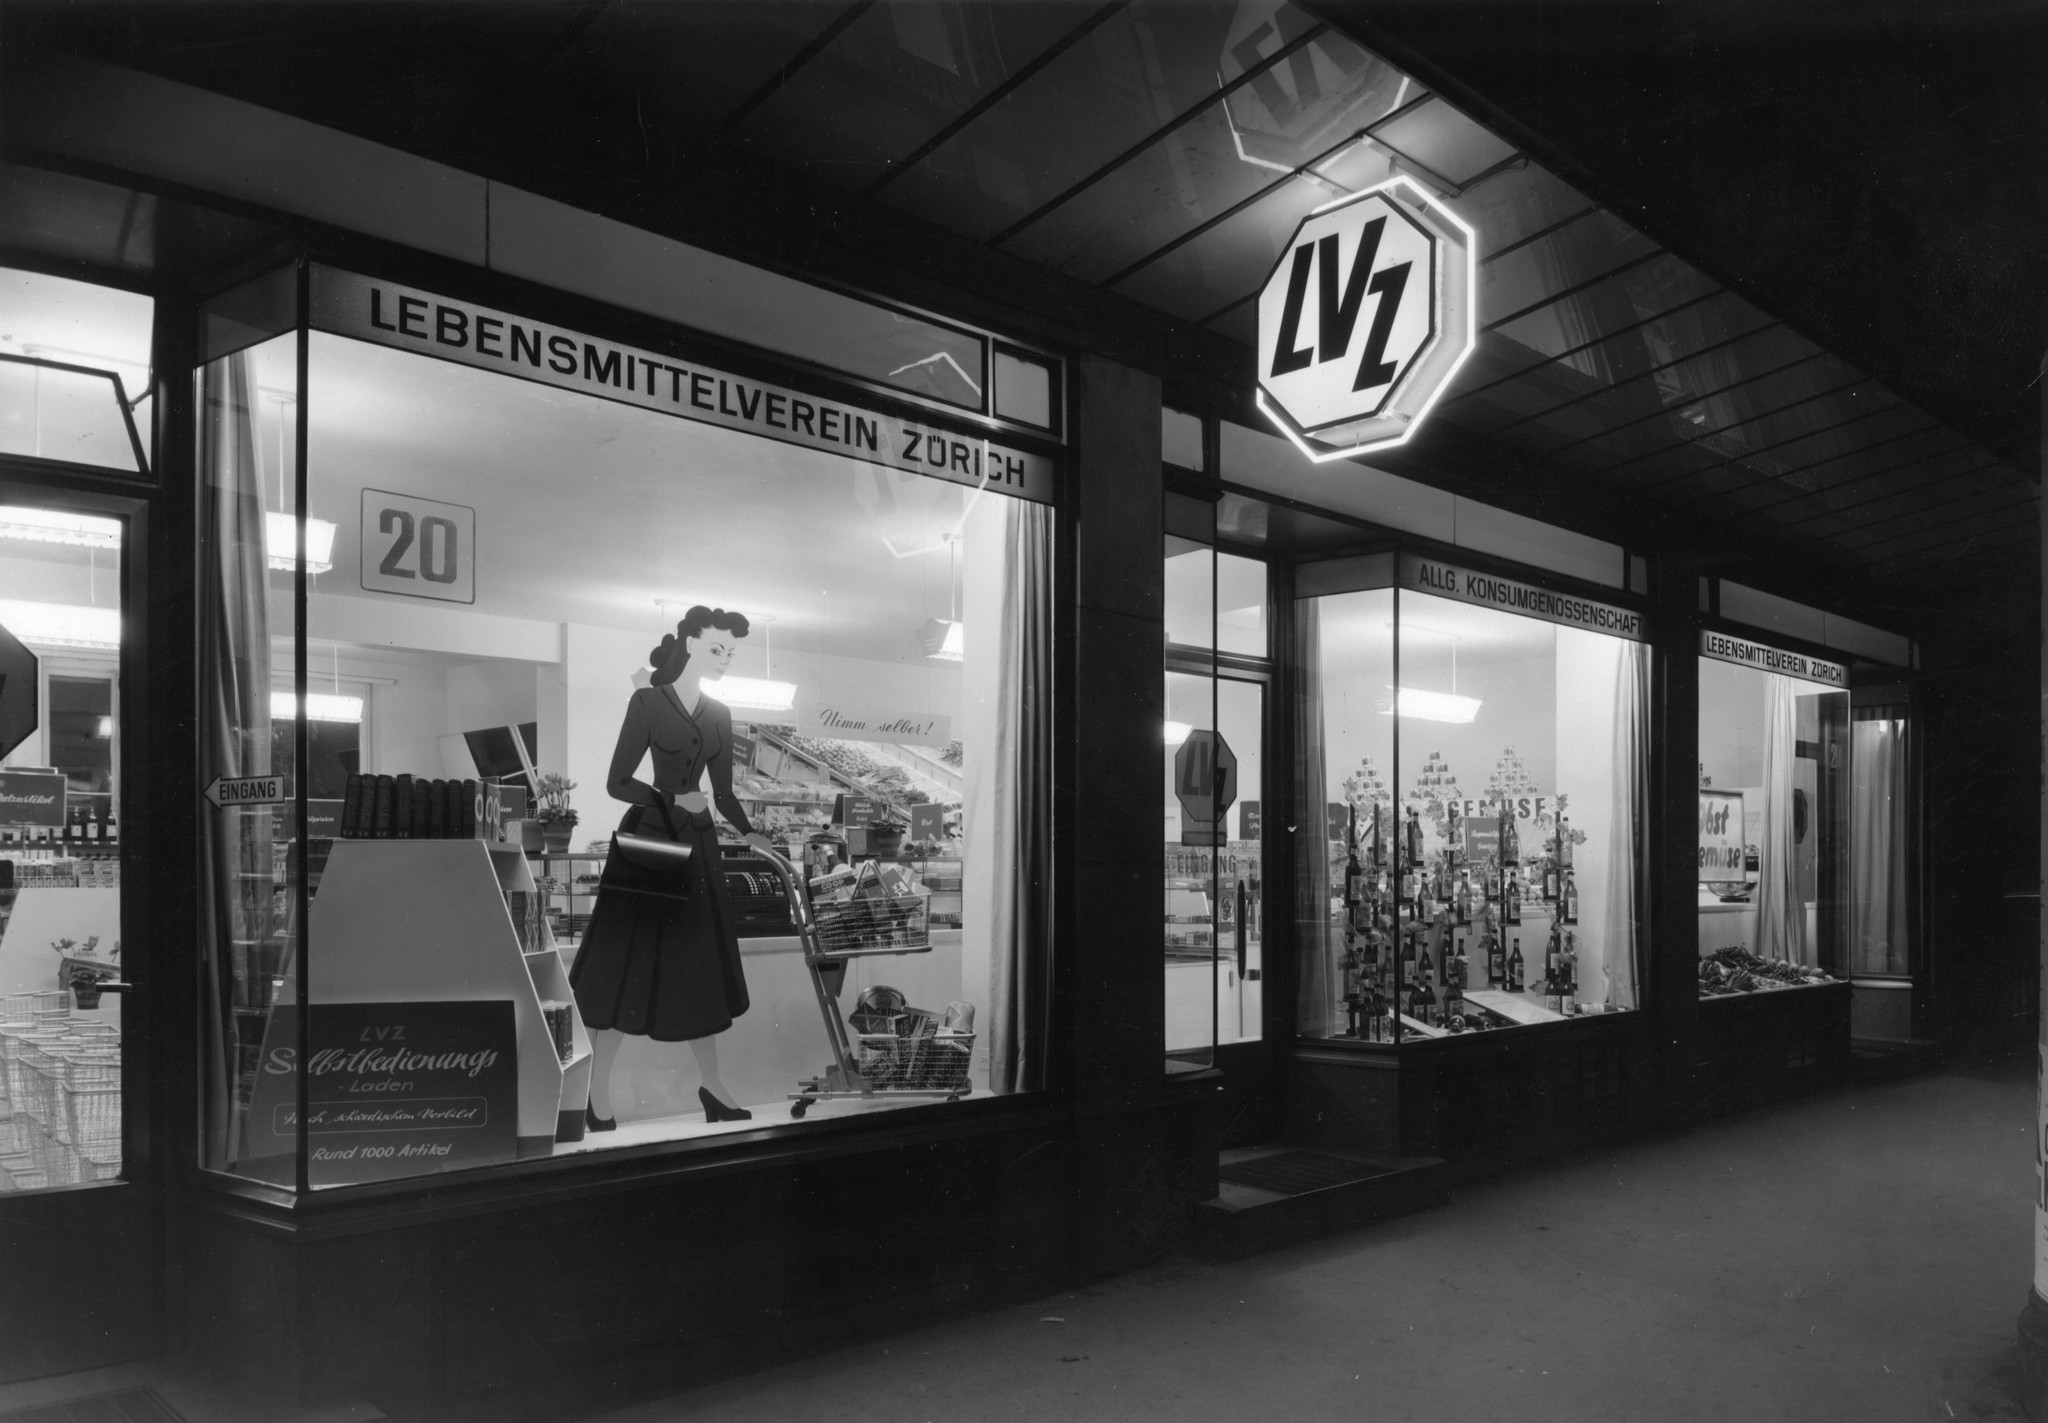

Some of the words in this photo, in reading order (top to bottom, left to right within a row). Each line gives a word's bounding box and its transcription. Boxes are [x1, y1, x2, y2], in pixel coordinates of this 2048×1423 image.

[1270, 215, 1413, 393] LVZ
[371, 288, 878, 452] LEBENSMITTELVEREIN
[902, 428, 1025, 489] ZÜRICH
[379, 508, 458, 584] 20
[1419, 563, 1460, 593] ALLG.
[1466, 574, 1643, 636] KONSUMGENOSSENSCHAFT
[1706, 635, 1807, 675] LEBENSMITTELVEREIN
[820, 708, 866, 730] Nimm
[873, 718, 934, 736] selber!
[220, 781, 276, 800] EINGANG
[1177, 854, 1236, 873] EINGNG
[1699, 839, 1741, 869] emüse
[359, 1026, 406, 1042] LVZ
[283, 1111, 323, 1126] Nch
[326, 1107, 415, 1126] schwedischem
[417, 1107, 477, 1120] Vorbild
[312, 1147, 356, 1160] Rund
[360, 1146, 394, 1159] 1000
[397, 1143, 452, 1156] Artikel
